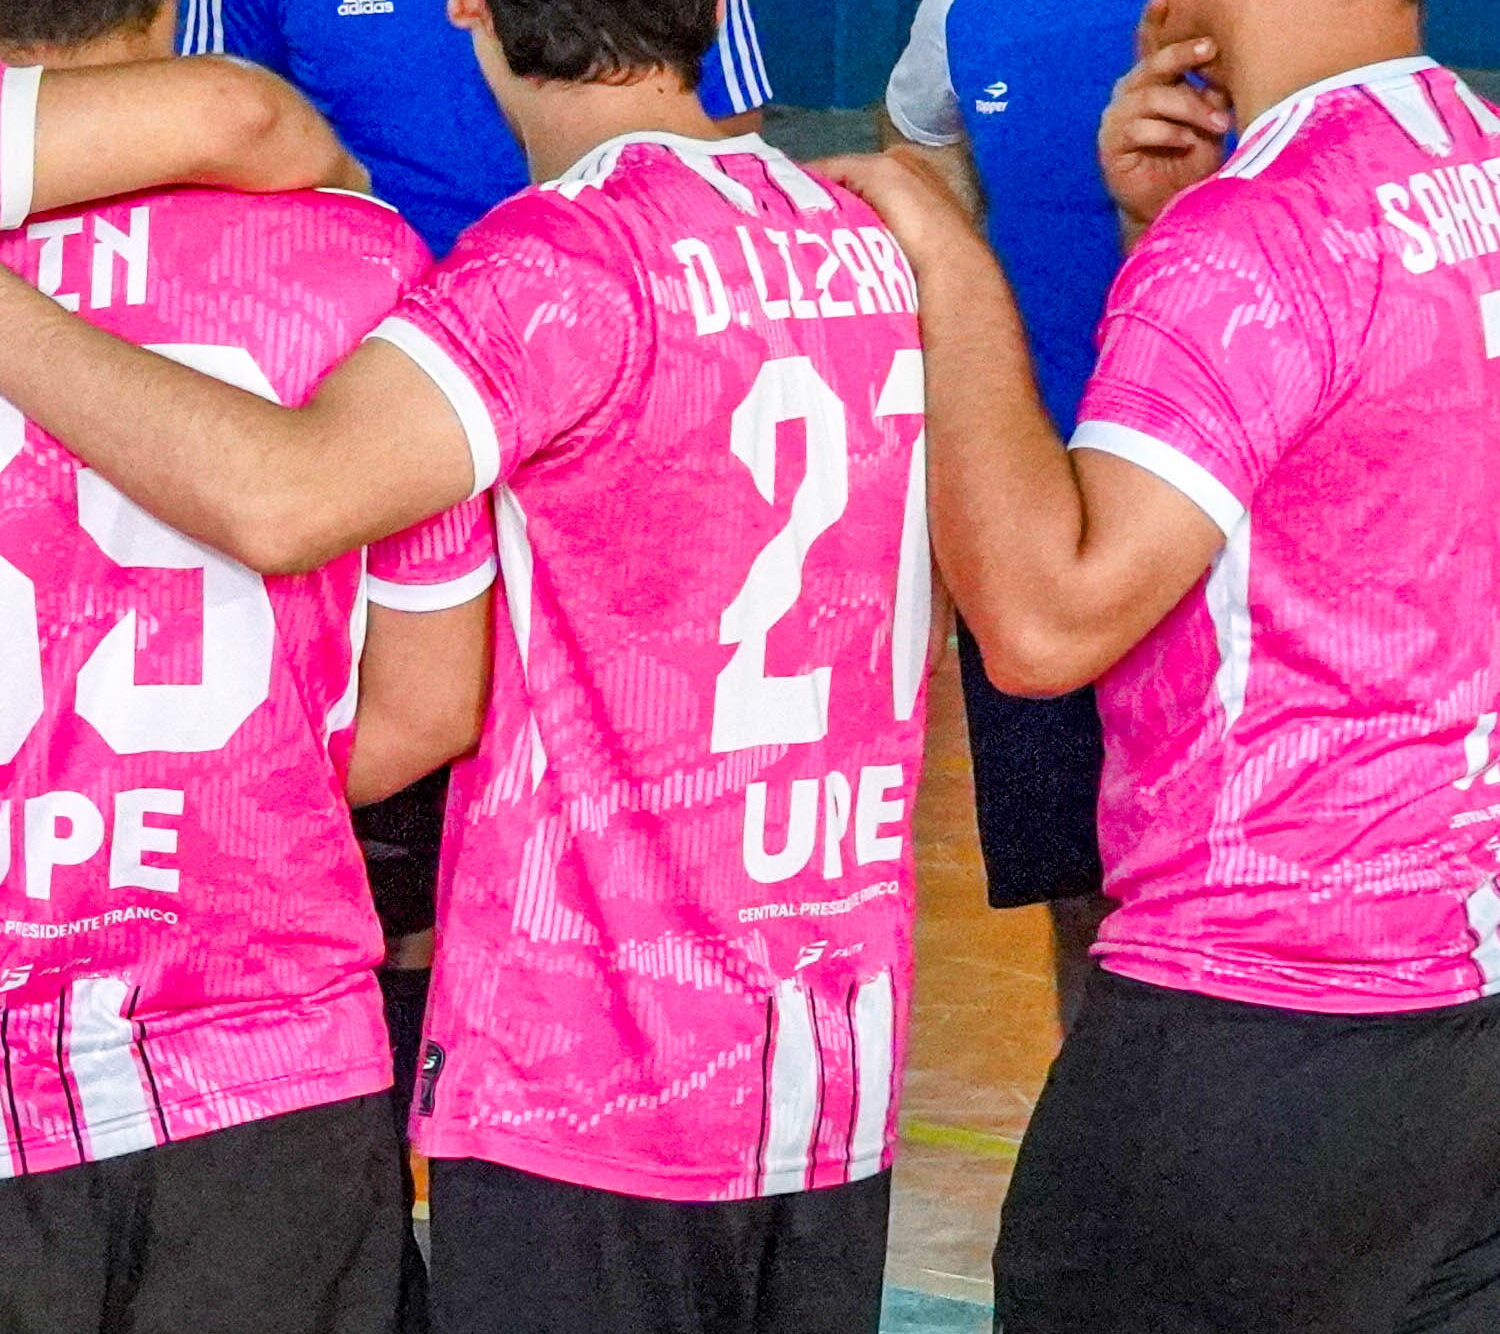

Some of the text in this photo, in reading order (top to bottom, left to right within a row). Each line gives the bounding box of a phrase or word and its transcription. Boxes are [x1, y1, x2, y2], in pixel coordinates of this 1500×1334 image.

[337, 0, 394, 16] adidas
[742, 763, 904, 884] UPE
[103, 906, 178, 927] FRANCO
[737, 902, 797, 924] CENTRAL
